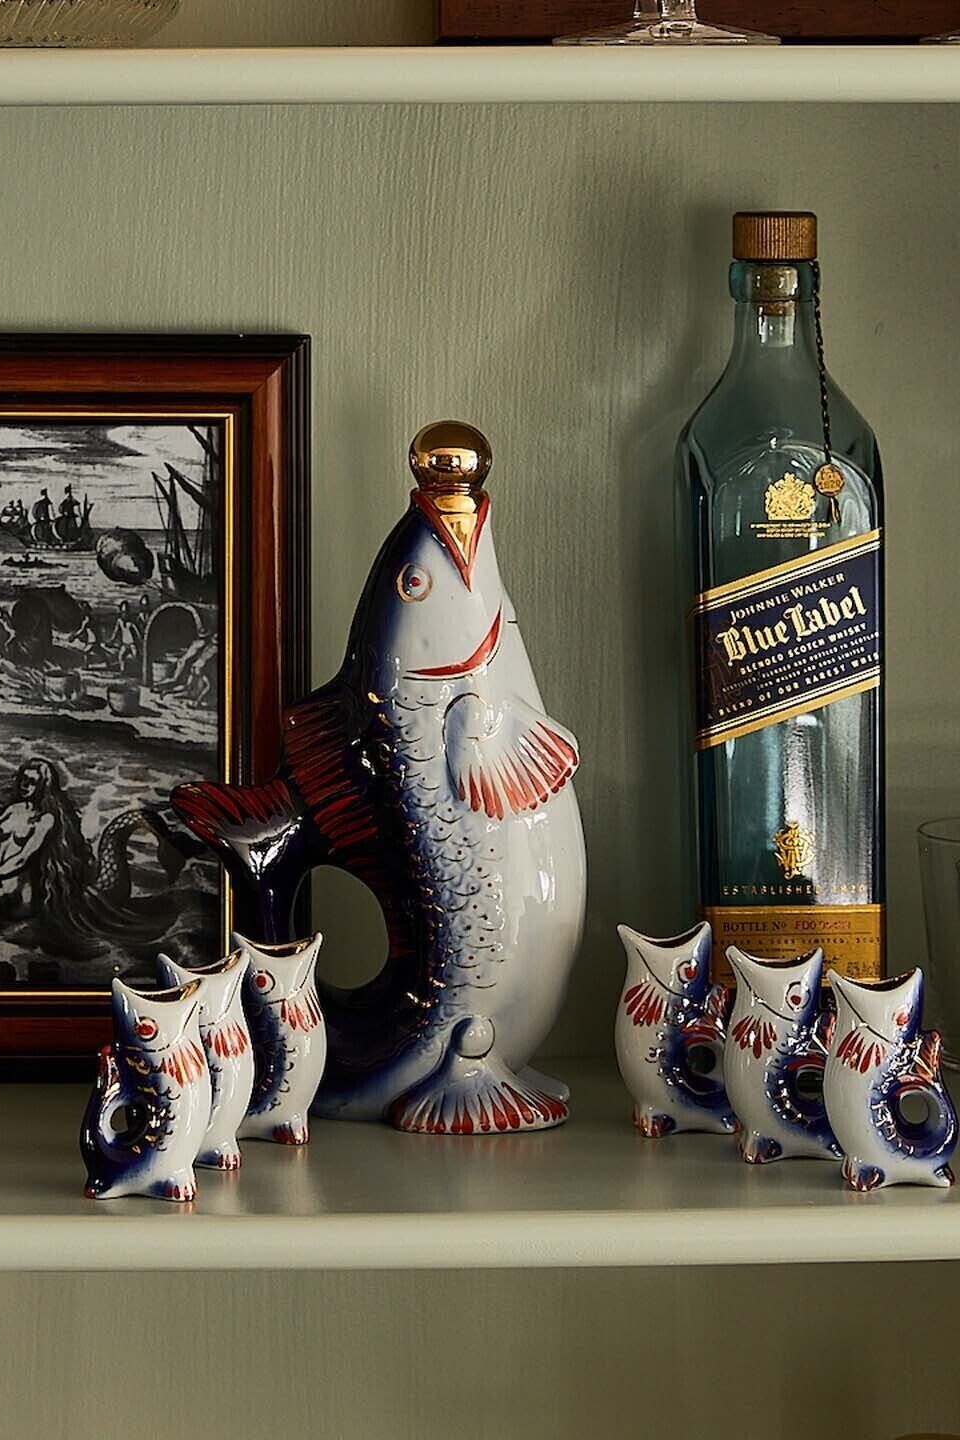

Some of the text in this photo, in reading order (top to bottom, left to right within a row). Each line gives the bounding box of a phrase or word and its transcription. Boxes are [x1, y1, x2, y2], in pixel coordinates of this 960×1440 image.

[730, 572, 846, 625] JOHNNIE WALKER
[715, 585, 868, 667] Blue Label
[740, 622, 867, 676] BLENDED SCOTCH WHISKY
[778, 680, 800, 696] OUR
[804, 664, 845, 686] RAREST
[722, 921, 768, 932] BOTTLE
